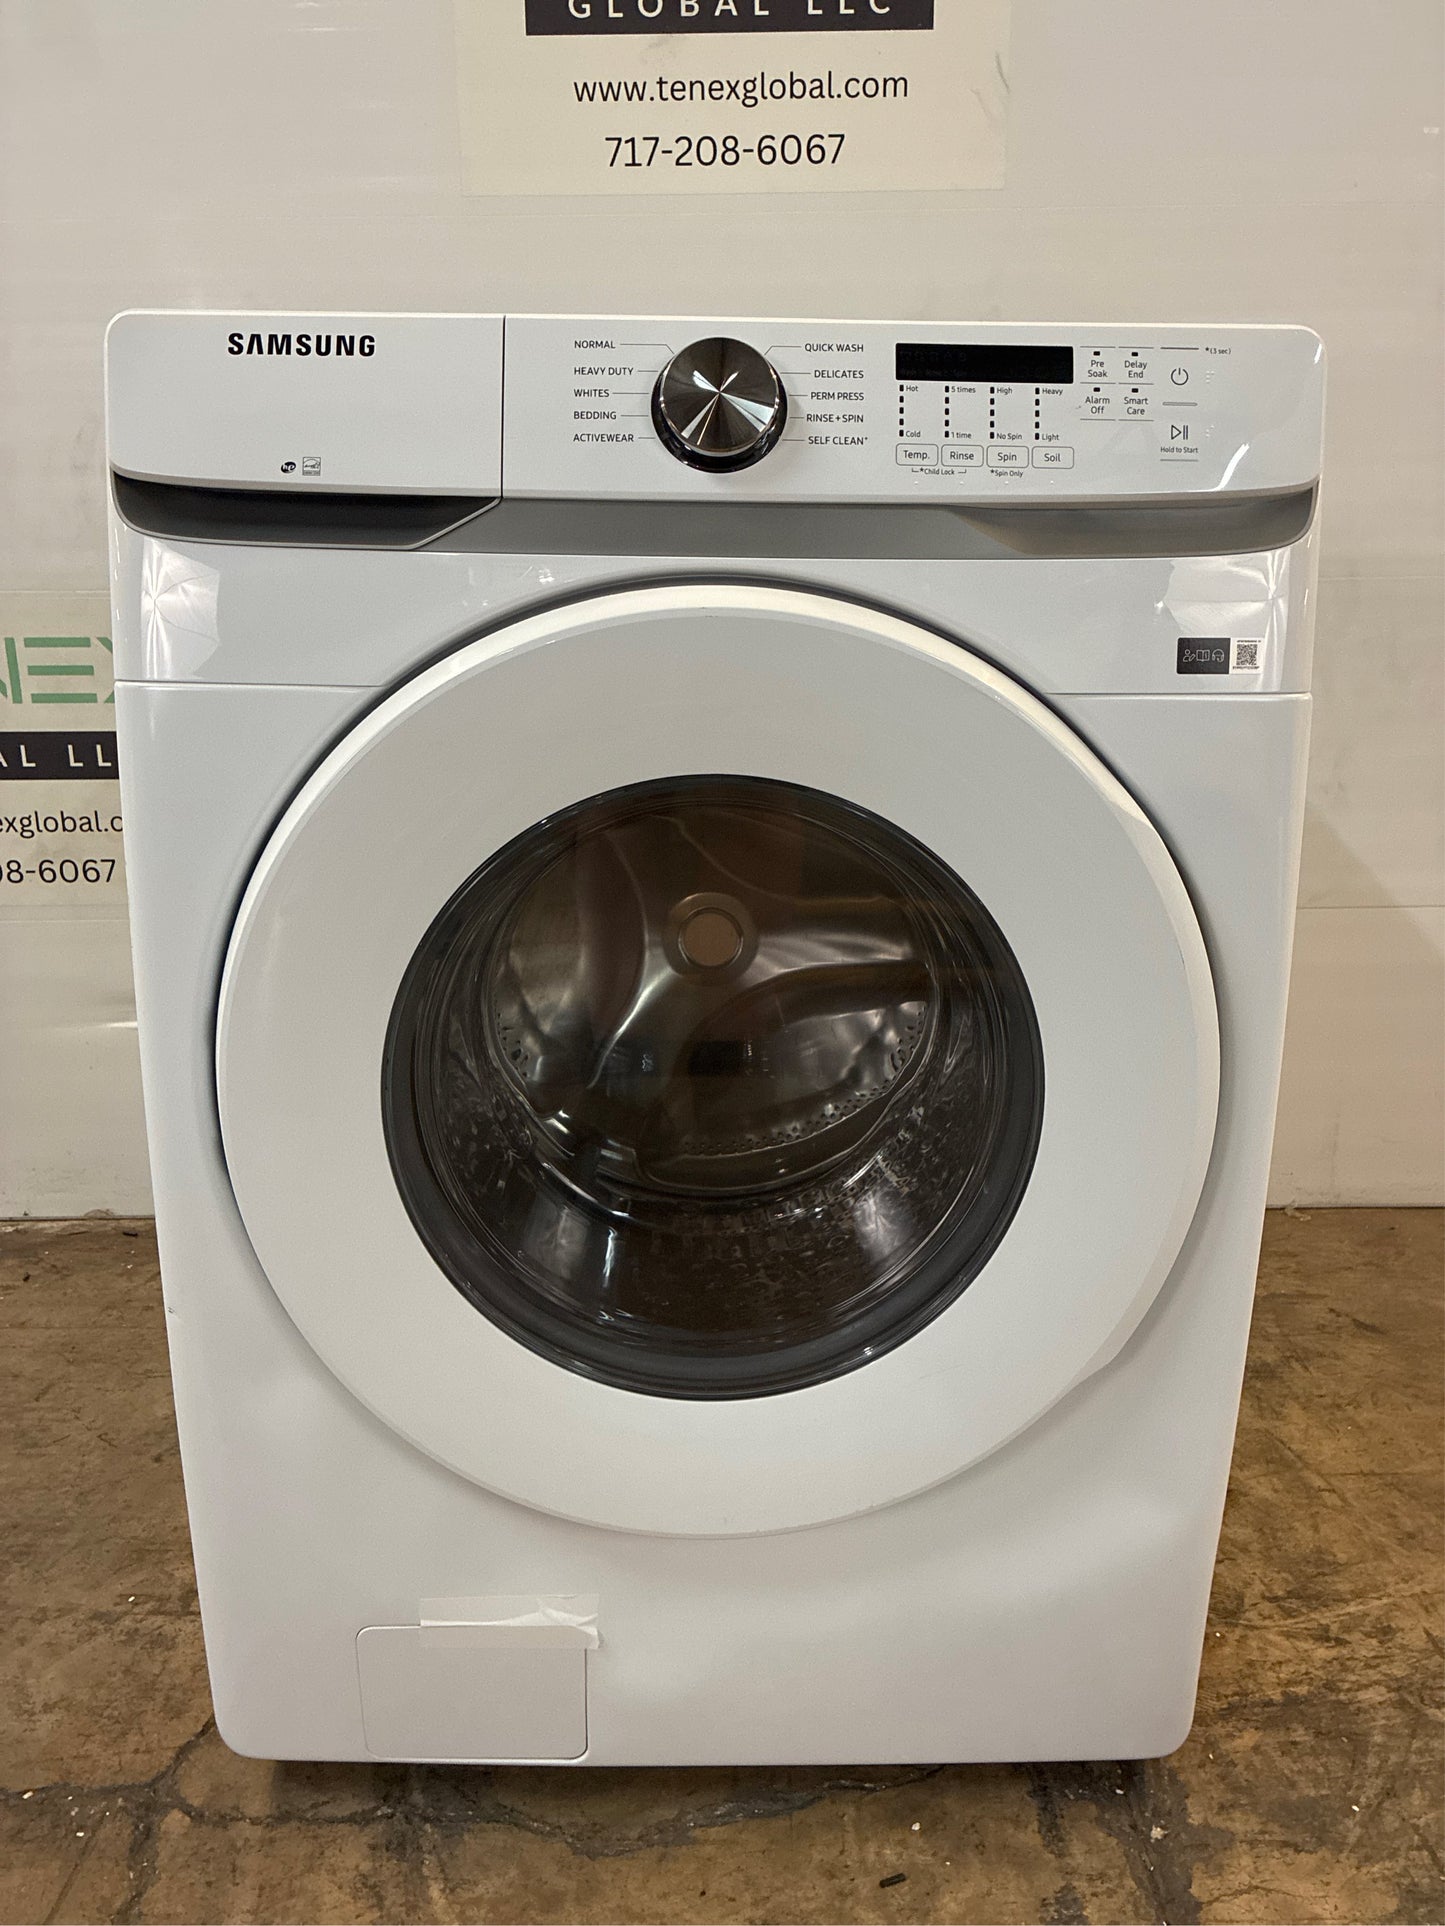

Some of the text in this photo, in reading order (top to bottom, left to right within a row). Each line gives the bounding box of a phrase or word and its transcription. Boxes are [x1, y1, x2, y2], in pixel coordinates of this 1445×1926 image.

[568, 0, 769, 18] GLOBAL
[574, 71, 907, 108] www.tenexglobal.com
[605, 134, 845, 167] 717-208-6067
[228, 333, 375, 357] SAMSUNG
[575, 340, 615, 349] NORMAL
[805, 343, 863, 352] QUICK WASH
[1125, 360, 1147, 371] Delay
[574, 367, 633, 375] HEAVY DUTY
[814, 370, 864, 378] DELICATES
[1128, 369, 1144, 378] End
[574, 389, 609, 397] WHITES
[951, 385, 956, 393] 5
[997, 387, 1012, 395] High
[1041, 387, 1064, 396] Heavy
[811, 392, 864, 401] PERM PRESS
[1085, 396, 1110, 404] Alarm
[1124, 397, 1148, 405] Smart
[1091, 406, 1104, 414] Off
[1127, 407, 1145, 415] Care
[574, 411, 616, 419] BEDDING
[807, 414, 834, 422] RINSE
[842, 414, 863, 422] SPIN
[573, 434, 633, 442] ACTIVEWEAR
[808, 436, 830, 444] SELF
[1007, 433, 1023, 442] Spin
[1041, 433, 1060, 443] Light
[903, 450, 930, 462] Temp.
[950, 451, 974, 460] Rinse
[998, 452, 1017, 462] Spin
[1044, 453, 1060, 462] Soil
[1009, 470, 1023, 478] Only
[0, 859, 116, 883] 8-6067
